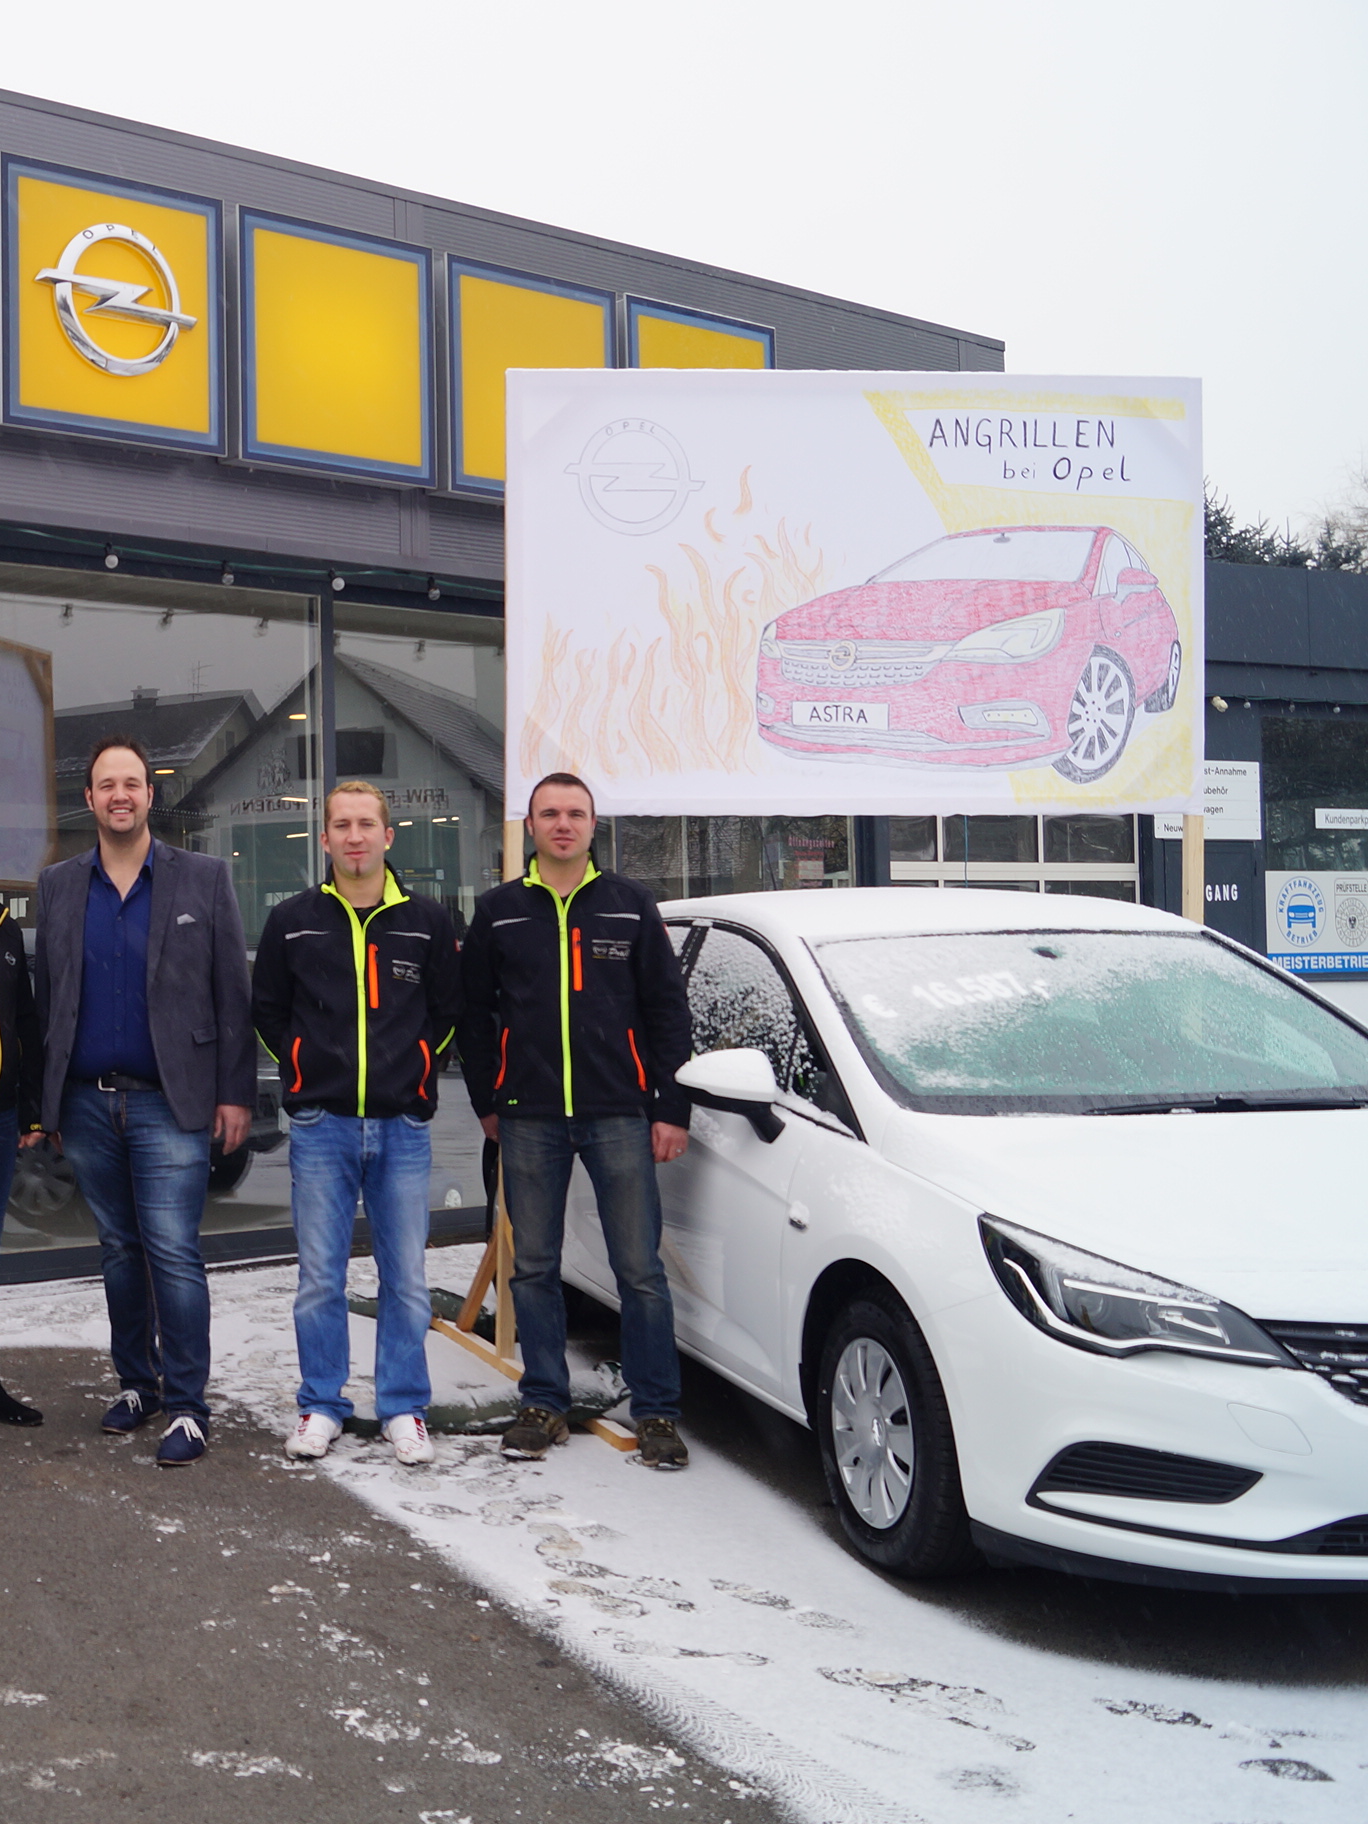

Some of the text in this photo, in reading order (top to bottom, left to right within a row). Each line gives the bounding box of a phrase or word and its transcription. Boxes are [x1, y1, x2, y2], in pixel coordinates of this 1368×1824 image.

[82, 223, 159, 257] OPEL
[604, 420, 657, 437] OPEL
[928, 416, 1116, 454] ANGRILLEN
[1002, 455, 1132, 491] bei Opel
[808, 704, 869, 724] ASTRA
[1203, 766, 1247, 777] st-Annahme
[1203, 785, 1229, 795] ubehör
[1163, 823, 1184, 832] Neuw
[1324, 813, 1368, 826] Kundenparkp
[1205, 884, 1238, 902] GANG
[1285, 929, 1319, 945] BETRIEB
[1272, 955, 1368, 970] MEISTERBETRIE
